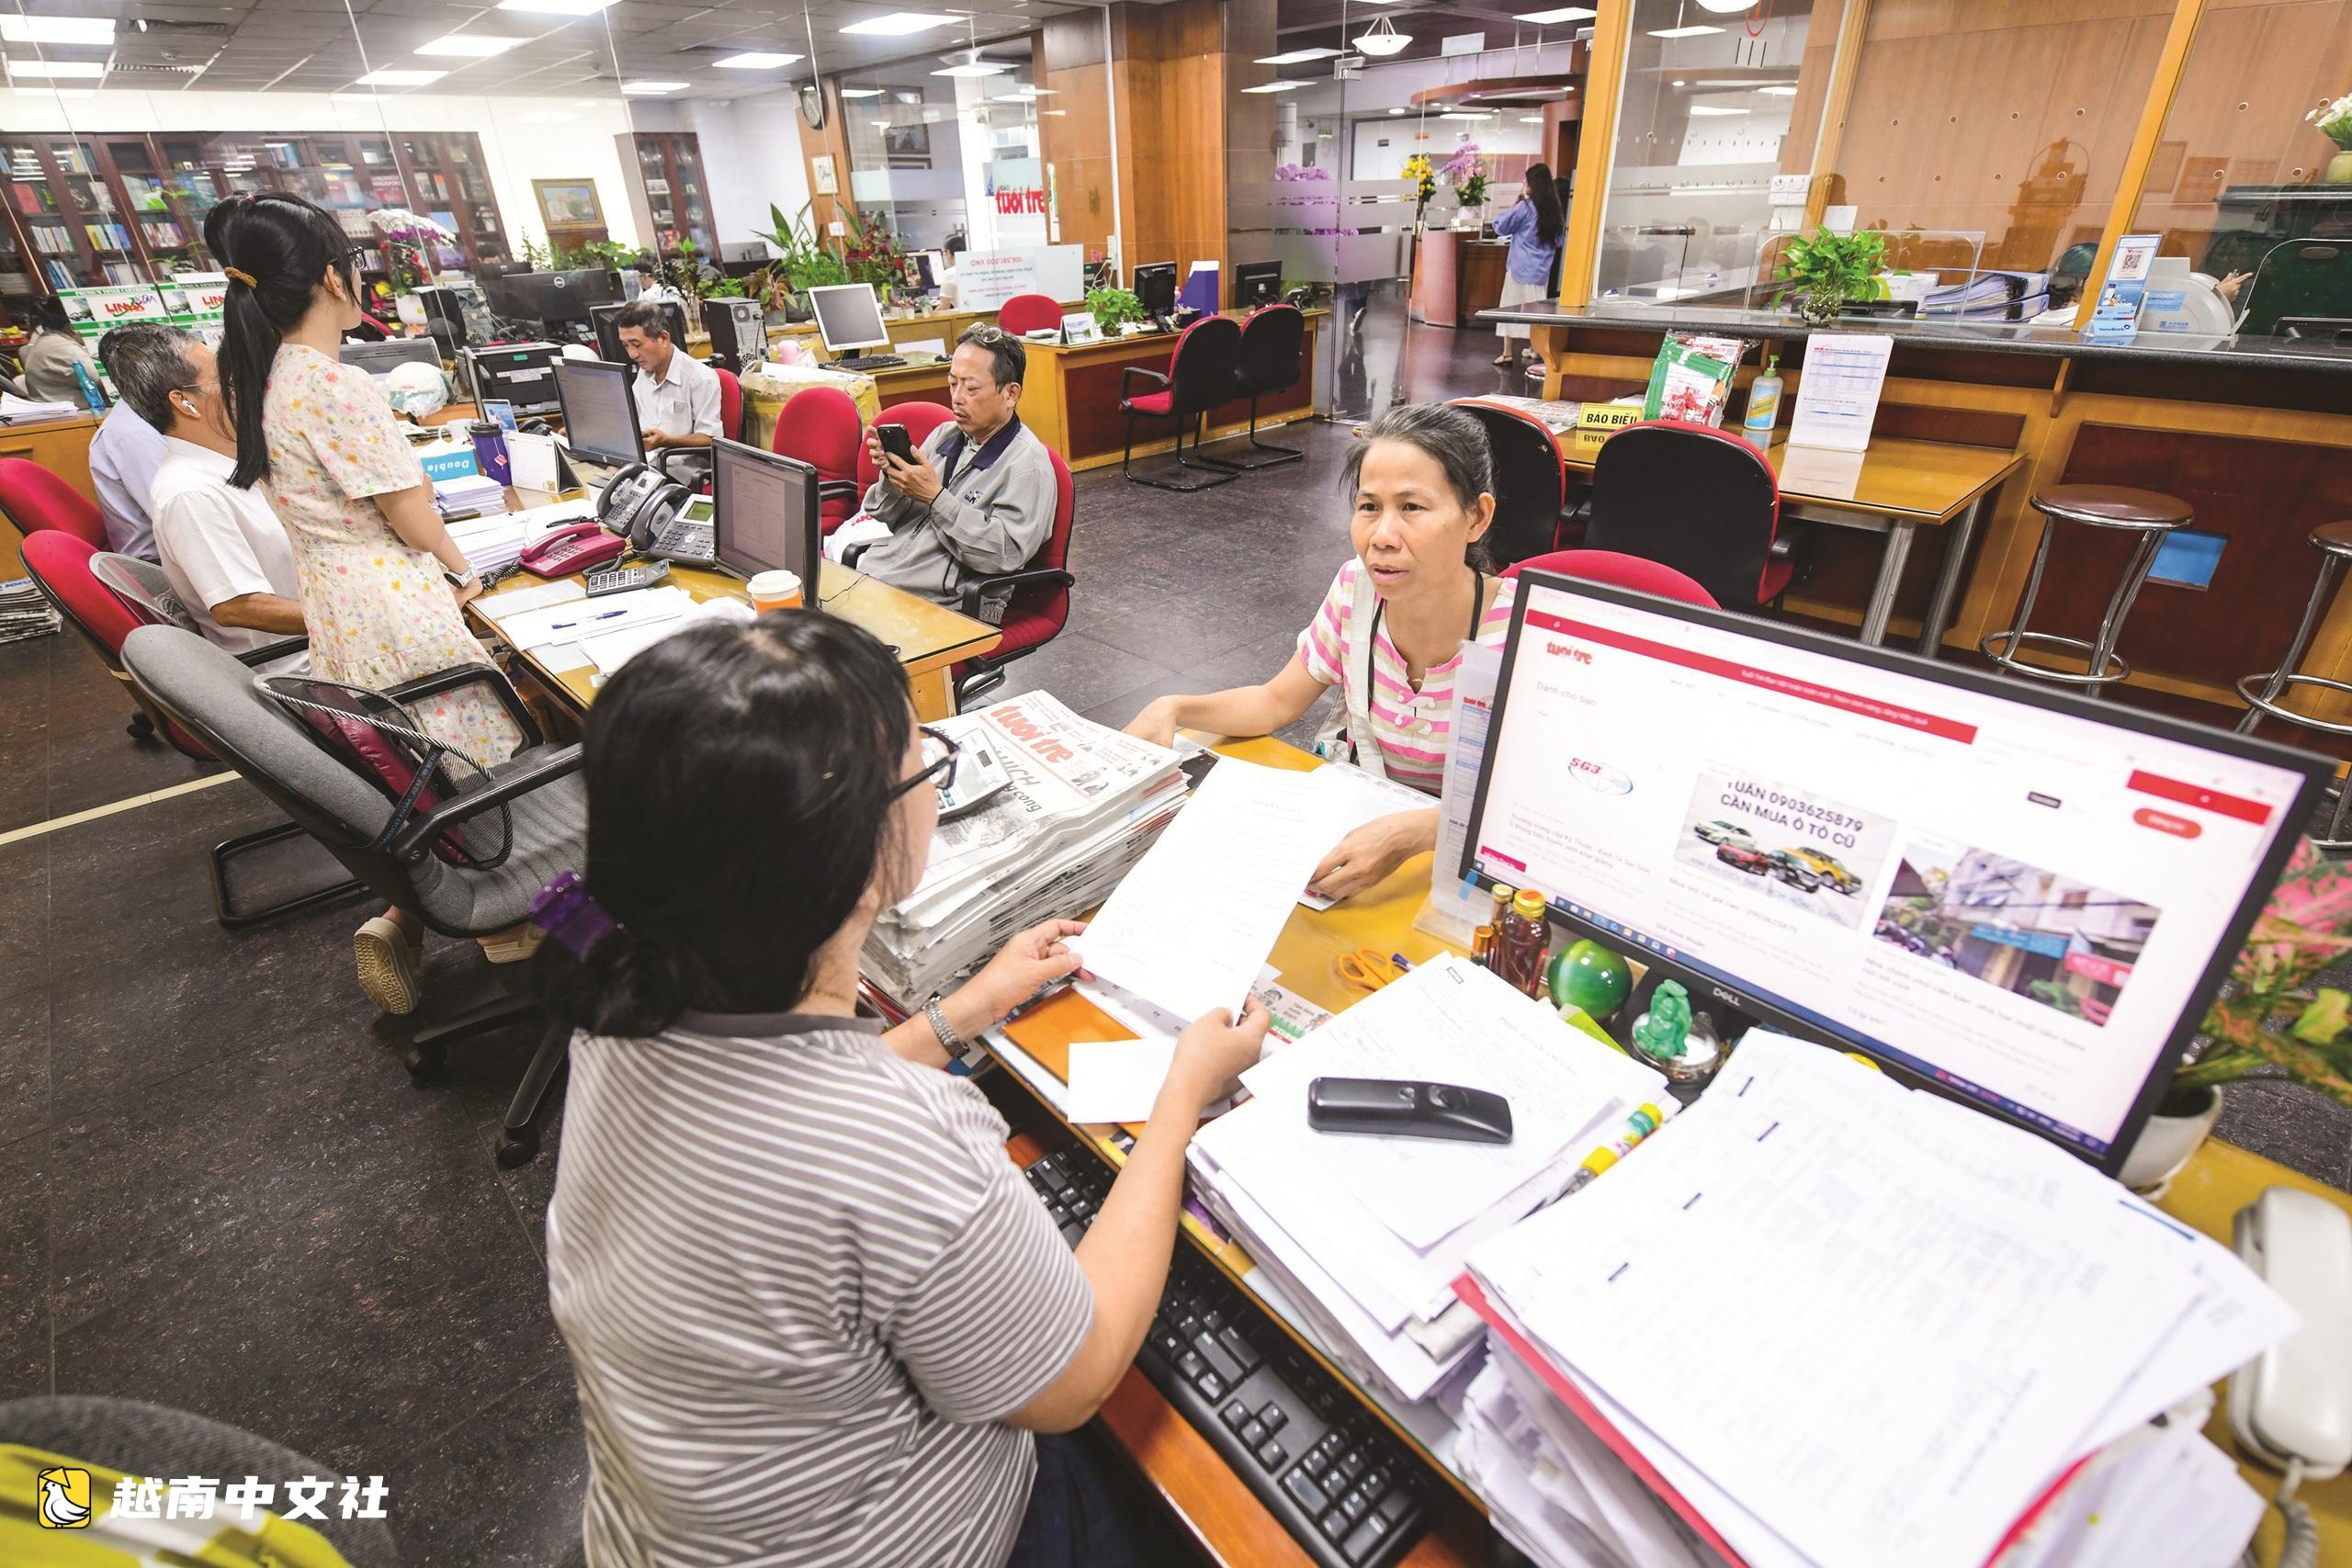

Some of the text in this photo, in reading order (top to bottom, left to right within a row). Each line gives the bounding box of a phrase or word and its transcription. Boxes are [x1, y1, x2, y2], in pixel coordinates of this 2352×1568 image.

[1586, 412, 1609, 424] BÁO
[427, 458, 469, 471] Double
[1569, 757, 1602, 775] SG3
[1755, 806, 1788, 827] MUA
[1770, 792, 1864, 832] 0903625879
[1713, 987, 1741, 1007] DELL
